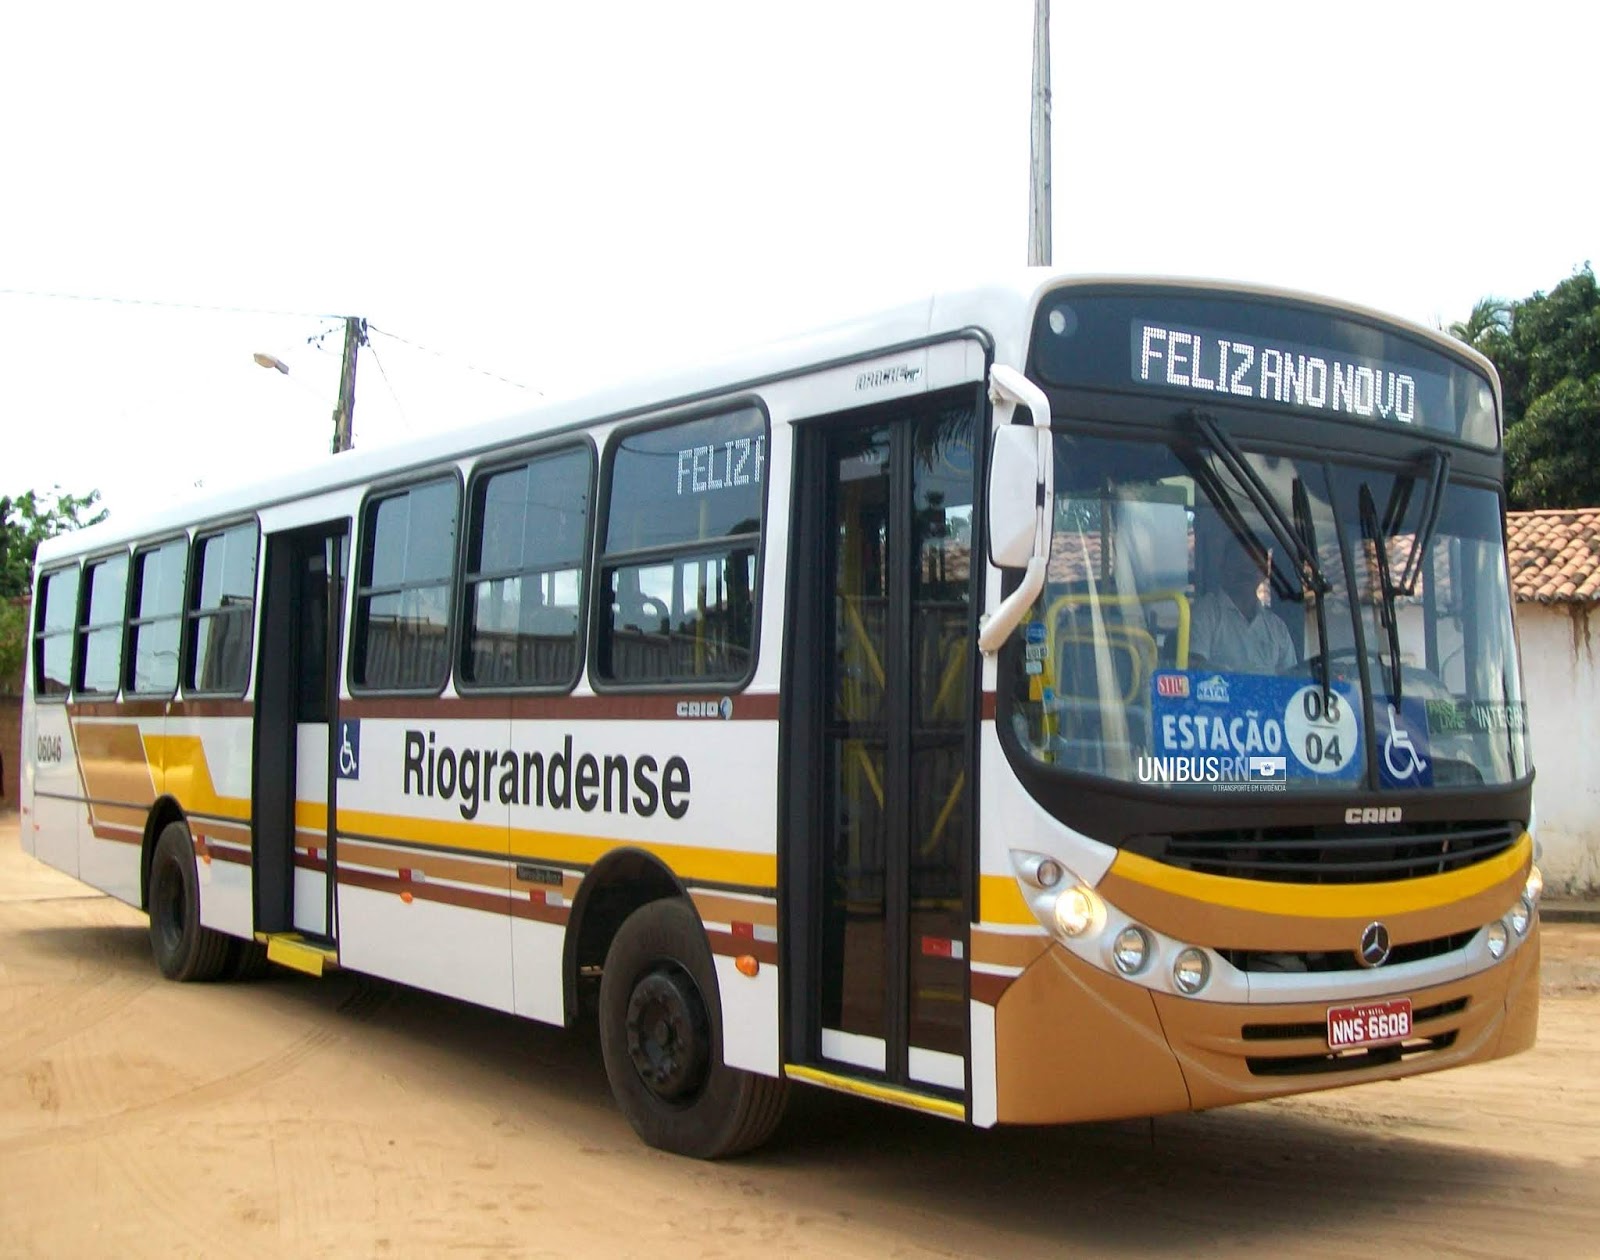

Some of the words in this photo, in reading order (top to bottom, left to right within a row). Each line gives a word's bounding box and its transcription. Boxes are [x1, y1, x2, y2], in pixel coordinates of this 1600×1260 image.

[1140, 326, 1254, 397] FELIZ
[1259, 348, 1327, 409] ANO
[1331, 361, 1415, 423] NOVO
[677, 437, 751, 495] FELIZ
[676, 701, 719, 718] CAIO
[1162, 709, 1282, 760] ESTAÇÃO
[403, 730, 691, 820] Riograndense
[1305, 732, 1343, 767] 04
[1345, 807, 1402, 824] CAIO
